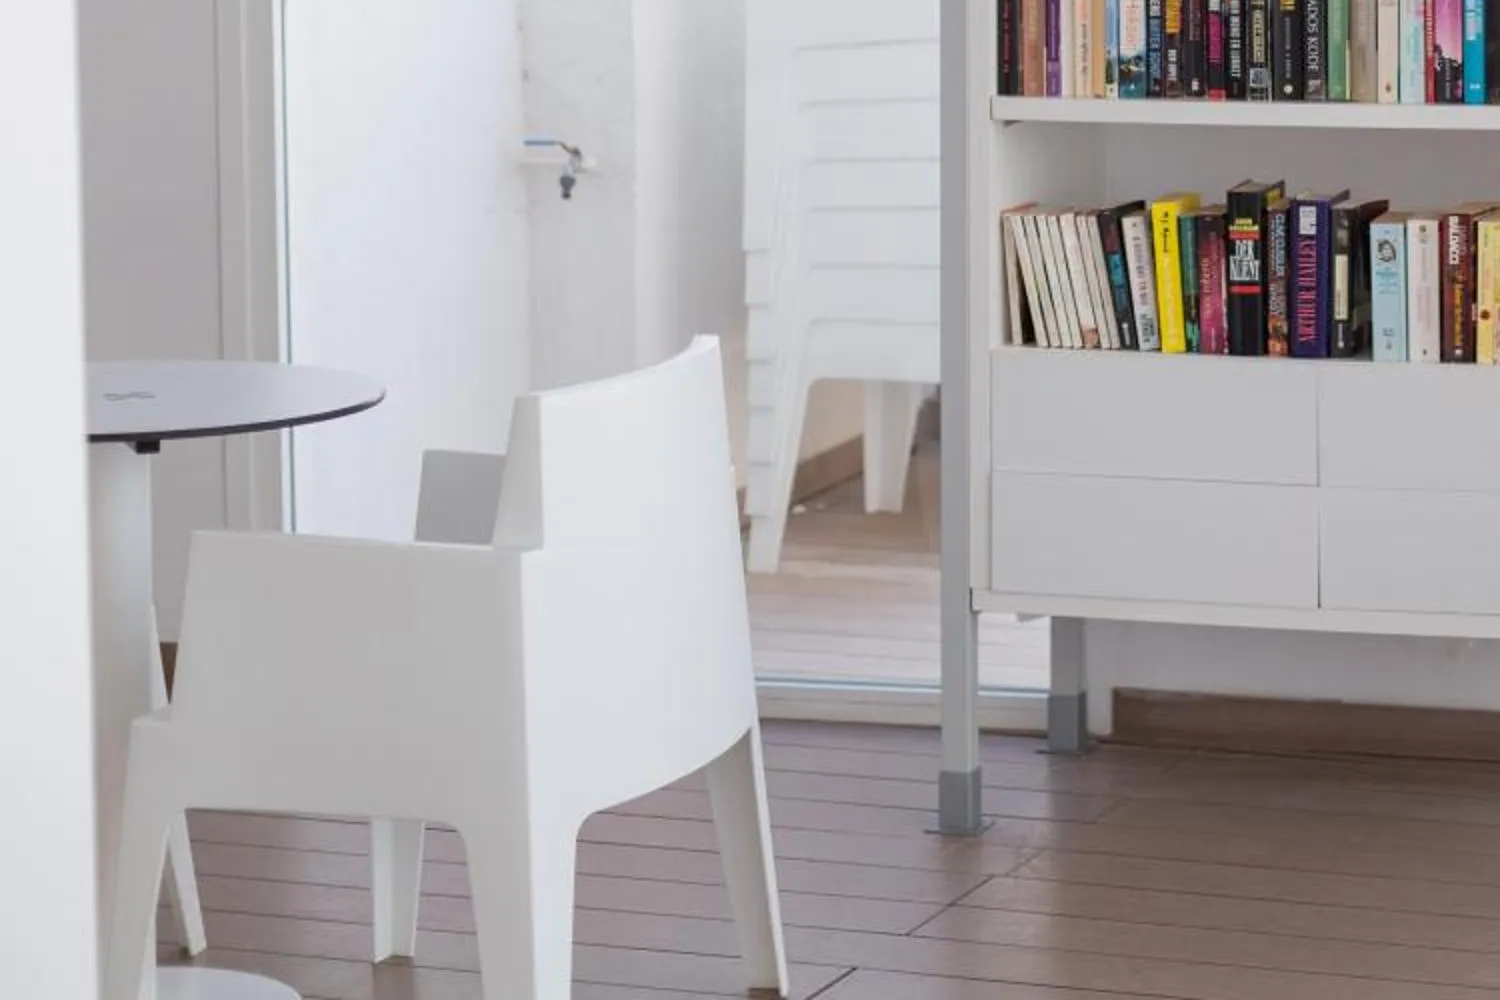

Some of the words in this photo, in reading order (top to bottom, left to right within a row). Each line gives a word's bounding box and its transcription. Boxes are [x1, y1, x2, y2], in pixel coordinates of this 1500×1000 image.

[1307, 36, 1319, 72] KODE
[1297, 237, 1317, 288] HAILEY
[1448, 215, 1460, 265] BALDACCI
[1297, 290, 1317, 344] ARTHUR
